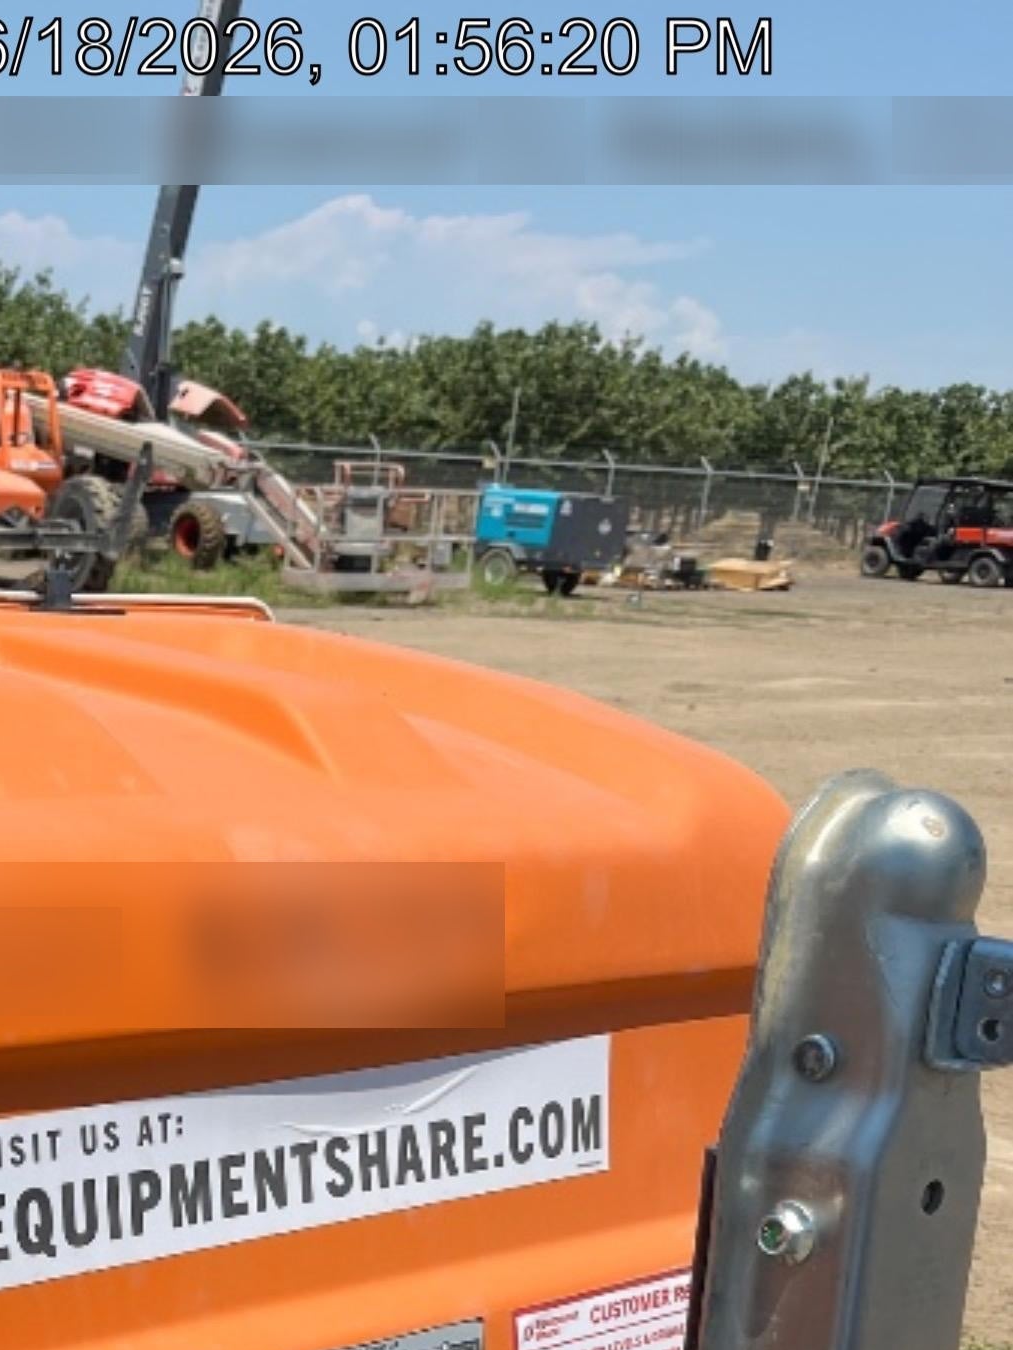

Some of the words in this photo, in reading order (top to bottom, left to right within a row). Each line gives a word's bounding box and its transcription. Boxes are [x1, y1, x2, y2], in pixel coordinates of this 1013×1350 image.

[80, 1120, 120, 1156] US
[136, 1112, 184, 1147] AT:
[589, 1287, 671, 1324] CUSTOMER
